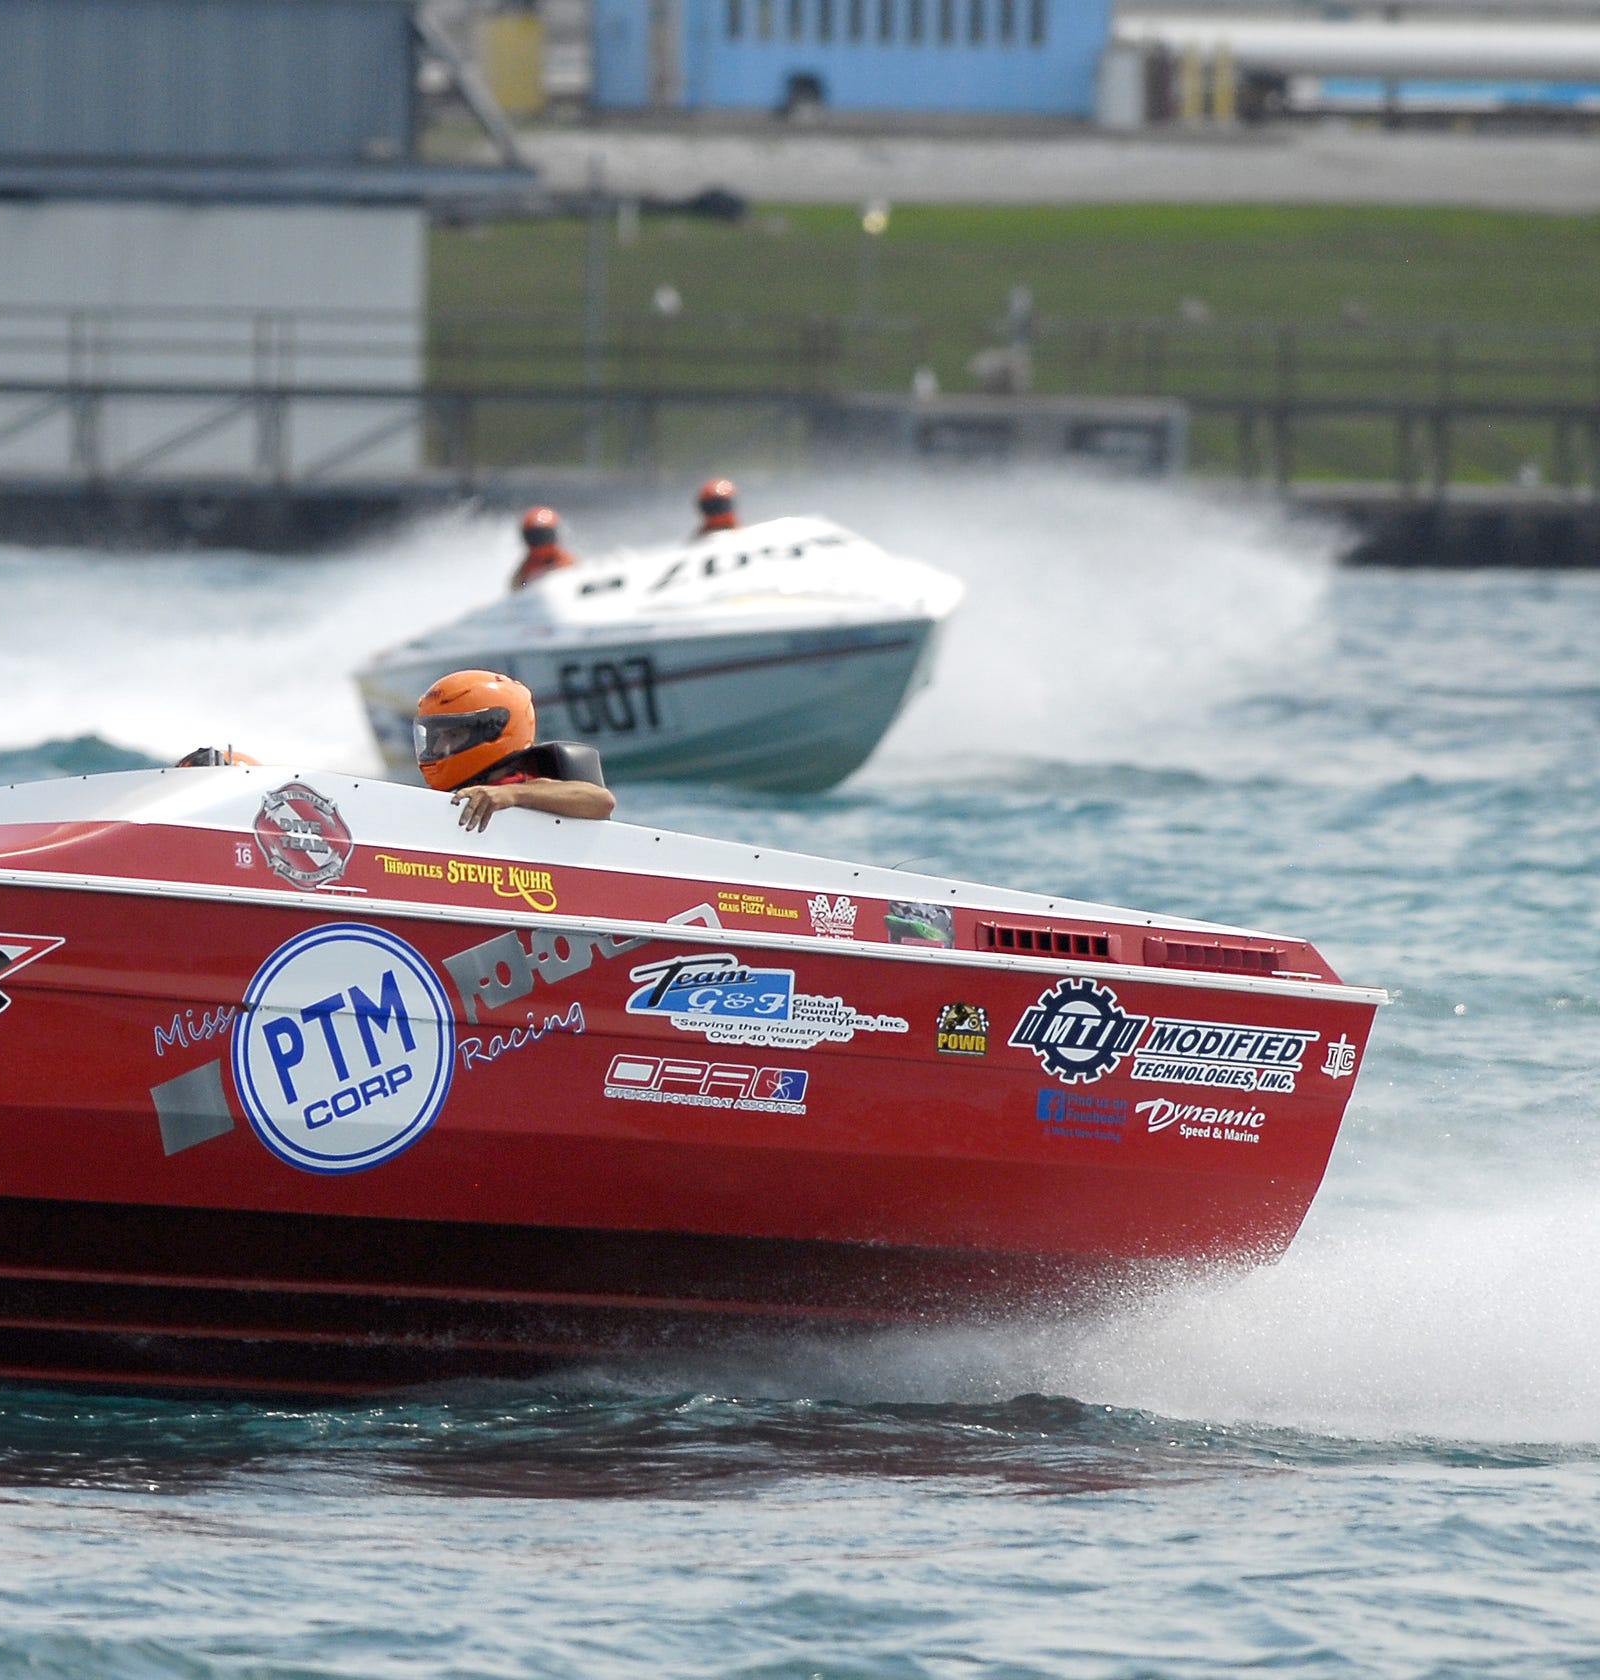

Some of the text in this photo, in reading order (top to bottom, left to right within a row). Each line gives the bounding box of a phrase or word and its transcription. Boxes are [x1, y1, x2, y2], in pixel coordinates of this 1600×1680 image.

[280, 818, 322, 834] DIVE
[280, 836, 328, 853] TEAM
[235, 848, 252, 864] 16
[374, 854, 443, 879] THROTTLES
[447, 860, 504, 886] STEVIE
[717, 892, 765, 902] CREW CHIEF
[718, 901, 799, 919] CRAIG FUZZY WILLIAMS
[634, 958, 754, 1007] Team
[792, 1006, 851, 1018] Foundry
[793, 999, 839, 1009] Global
[153, 1006, 236, 1056] Miss
[739, 1023, 761, 1031] the
[767, 1025, 824, 1037] Industry
[829, 1029, 849, 1038] for
[880, 1019, 905, 1028] Inc.
[1041, 1015, 1116, 1047] MTI
[262, 969, 417, 1105] PTM
[458, 1002, 586, 1071] Racing
[710, 1031, 744, 1040] Over
[748, 1033, 766, 1042] 40
[938, 1033, 986, 1051] POWR
[1147, 1026, 1305, 1062] MODIFIED
[1133, 1061, 1294, 1090] TECHNOLOGIES, INC.
[303, 1064, 413, 1130] CORP
[604, 1087, 806, 1114] OFFSHORE POWERBOAT ASSOCIATION
[1135, 1098, 1266, 1132] Dynamic
[1180, 1124, 1260, 1143] Speed & Marine
